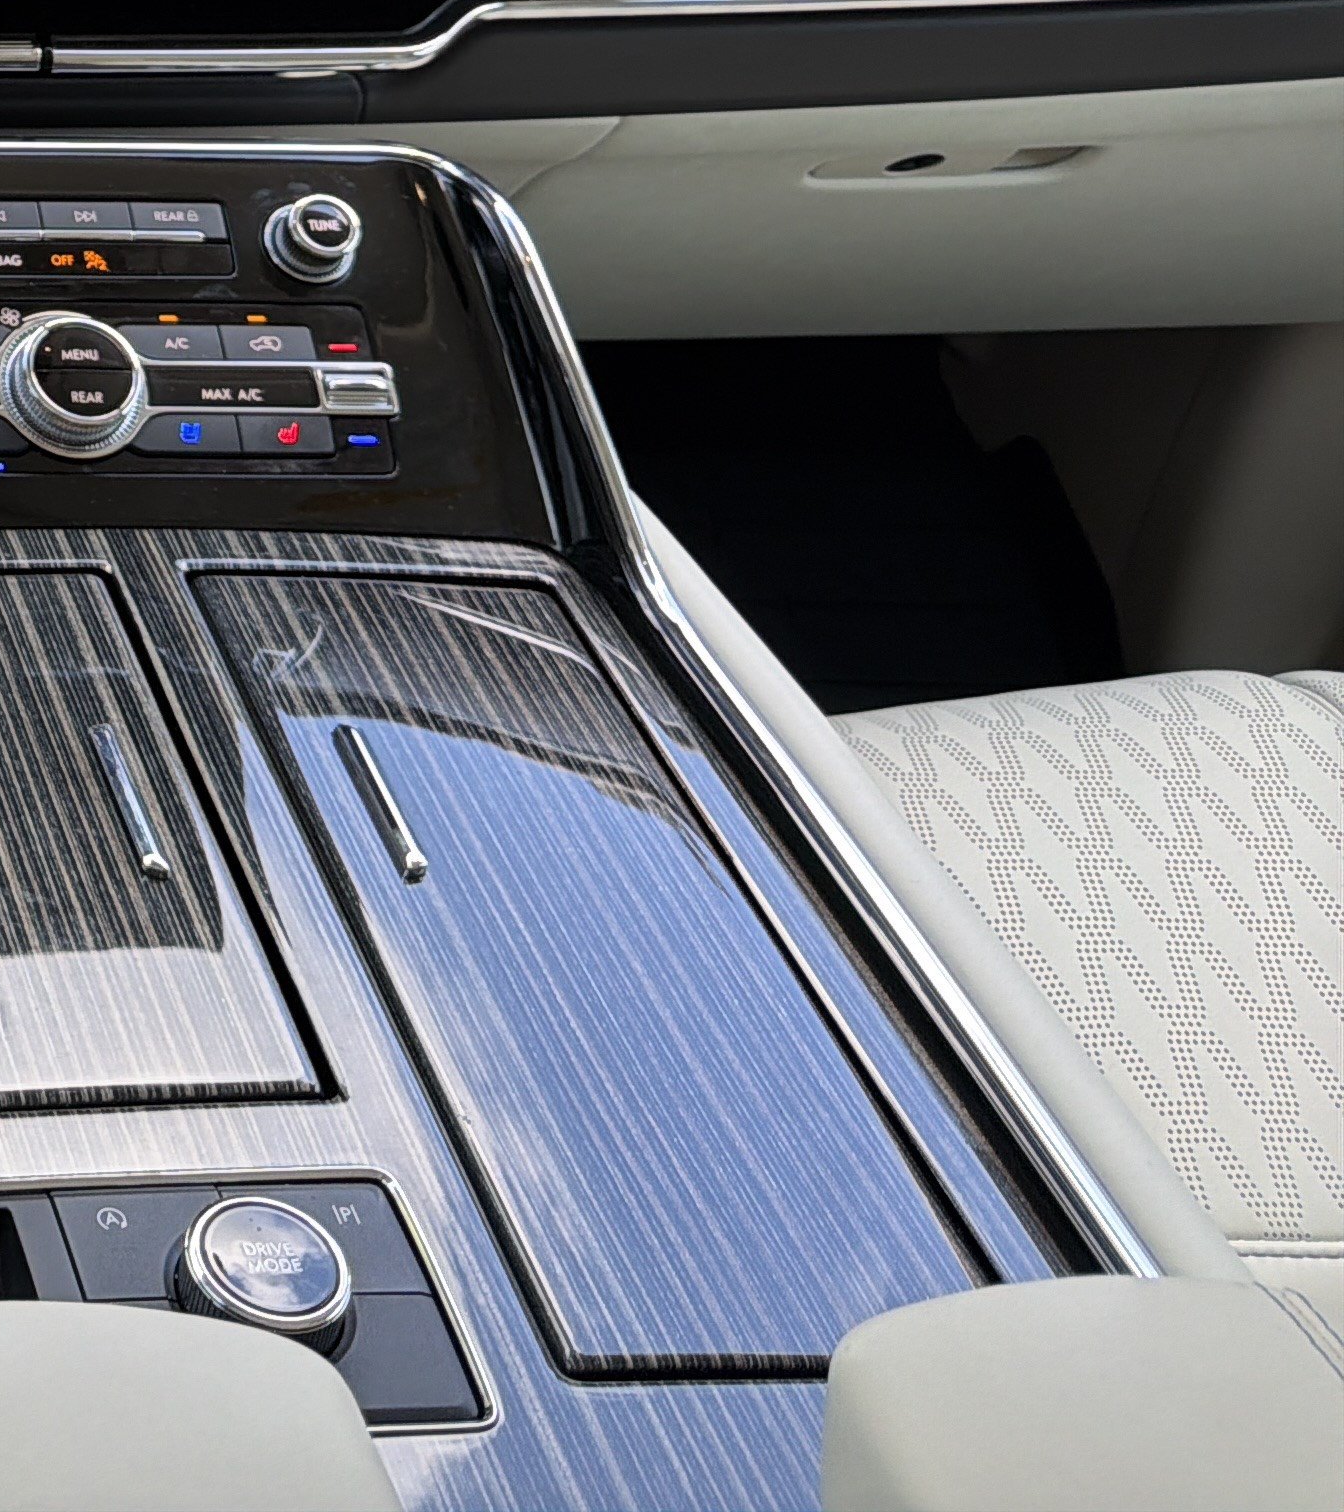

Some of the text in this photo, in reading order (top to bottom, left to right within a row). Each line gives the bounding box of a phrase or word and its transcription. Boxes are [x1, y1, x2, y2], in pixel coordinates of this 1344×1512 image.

[154, 210, 185, 222] REAR
[308, 219, 342, 232] TUNE
[50, 254, 75, 267] OFF
[164, 336, 190, 350] A/C
[61, 348, 100, 361] MENU
[70, 390, 105, 404] REAR
[201, 388, 265, 402] MAX A/C
[242, 1241, 296, 1258] DRIVE
[248, 1257, 304, 1274] MODE
